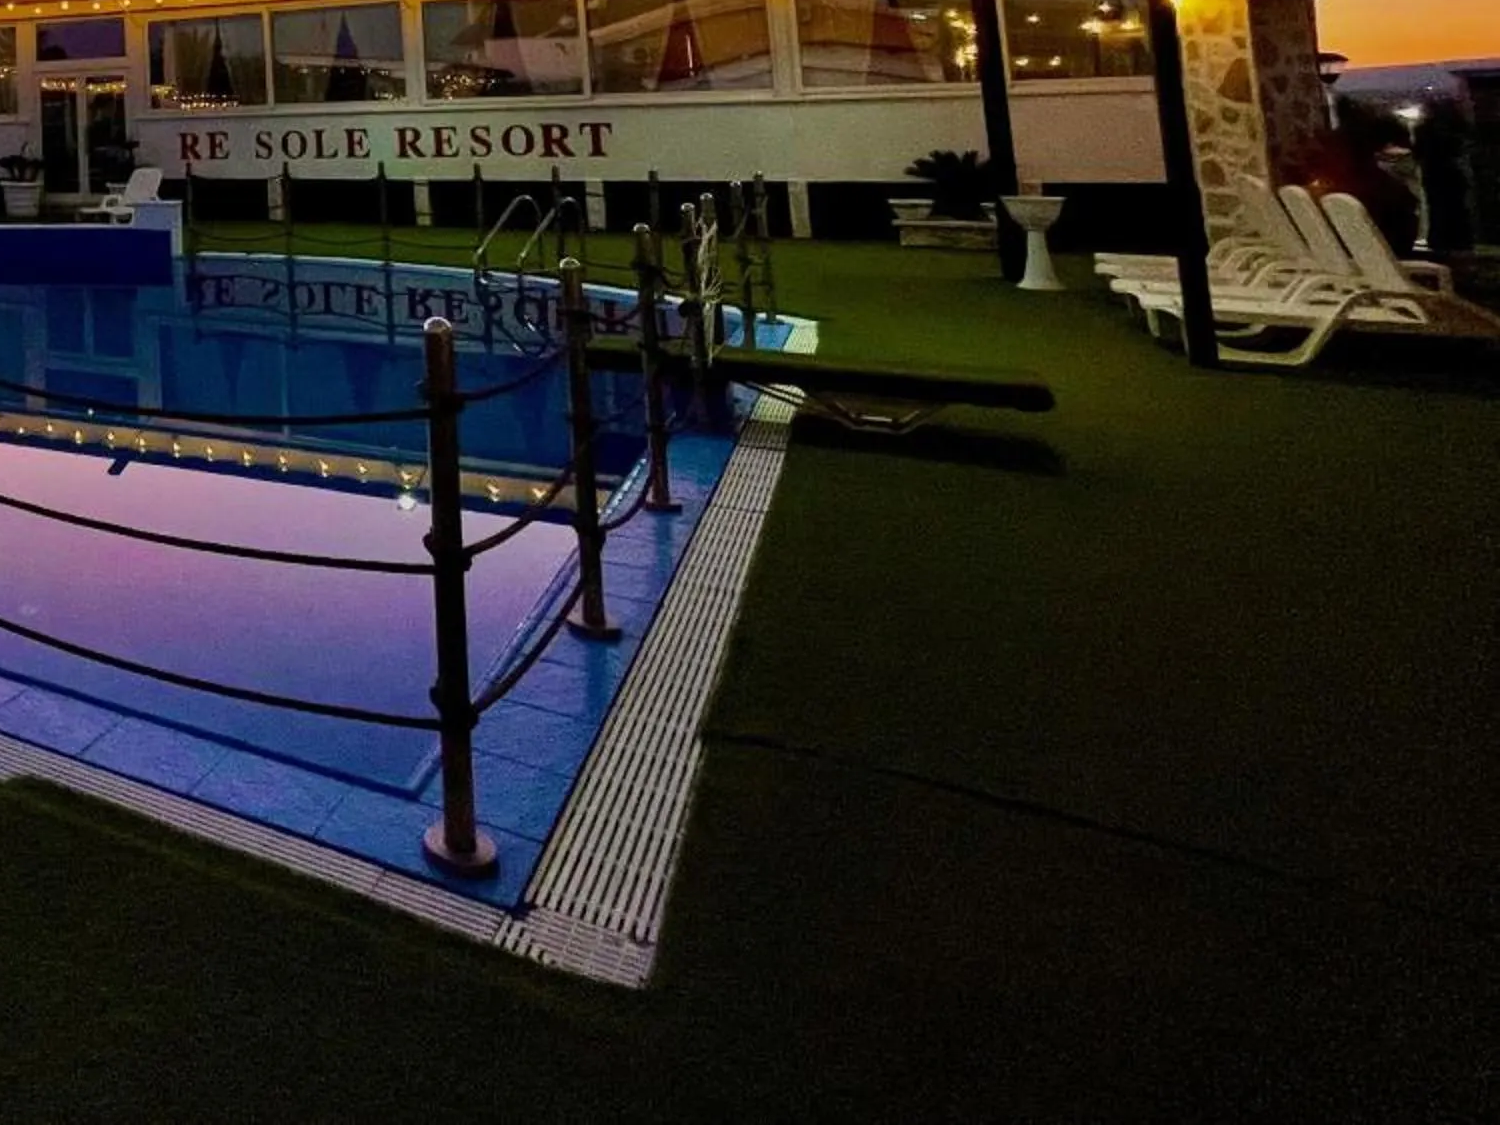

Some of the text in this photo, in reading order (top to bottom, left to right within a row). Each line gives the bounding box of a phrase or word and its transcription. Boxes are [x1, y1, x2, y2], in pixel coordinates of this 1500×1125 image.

[179, 122, 613, 160] RE SOLE RESORT
